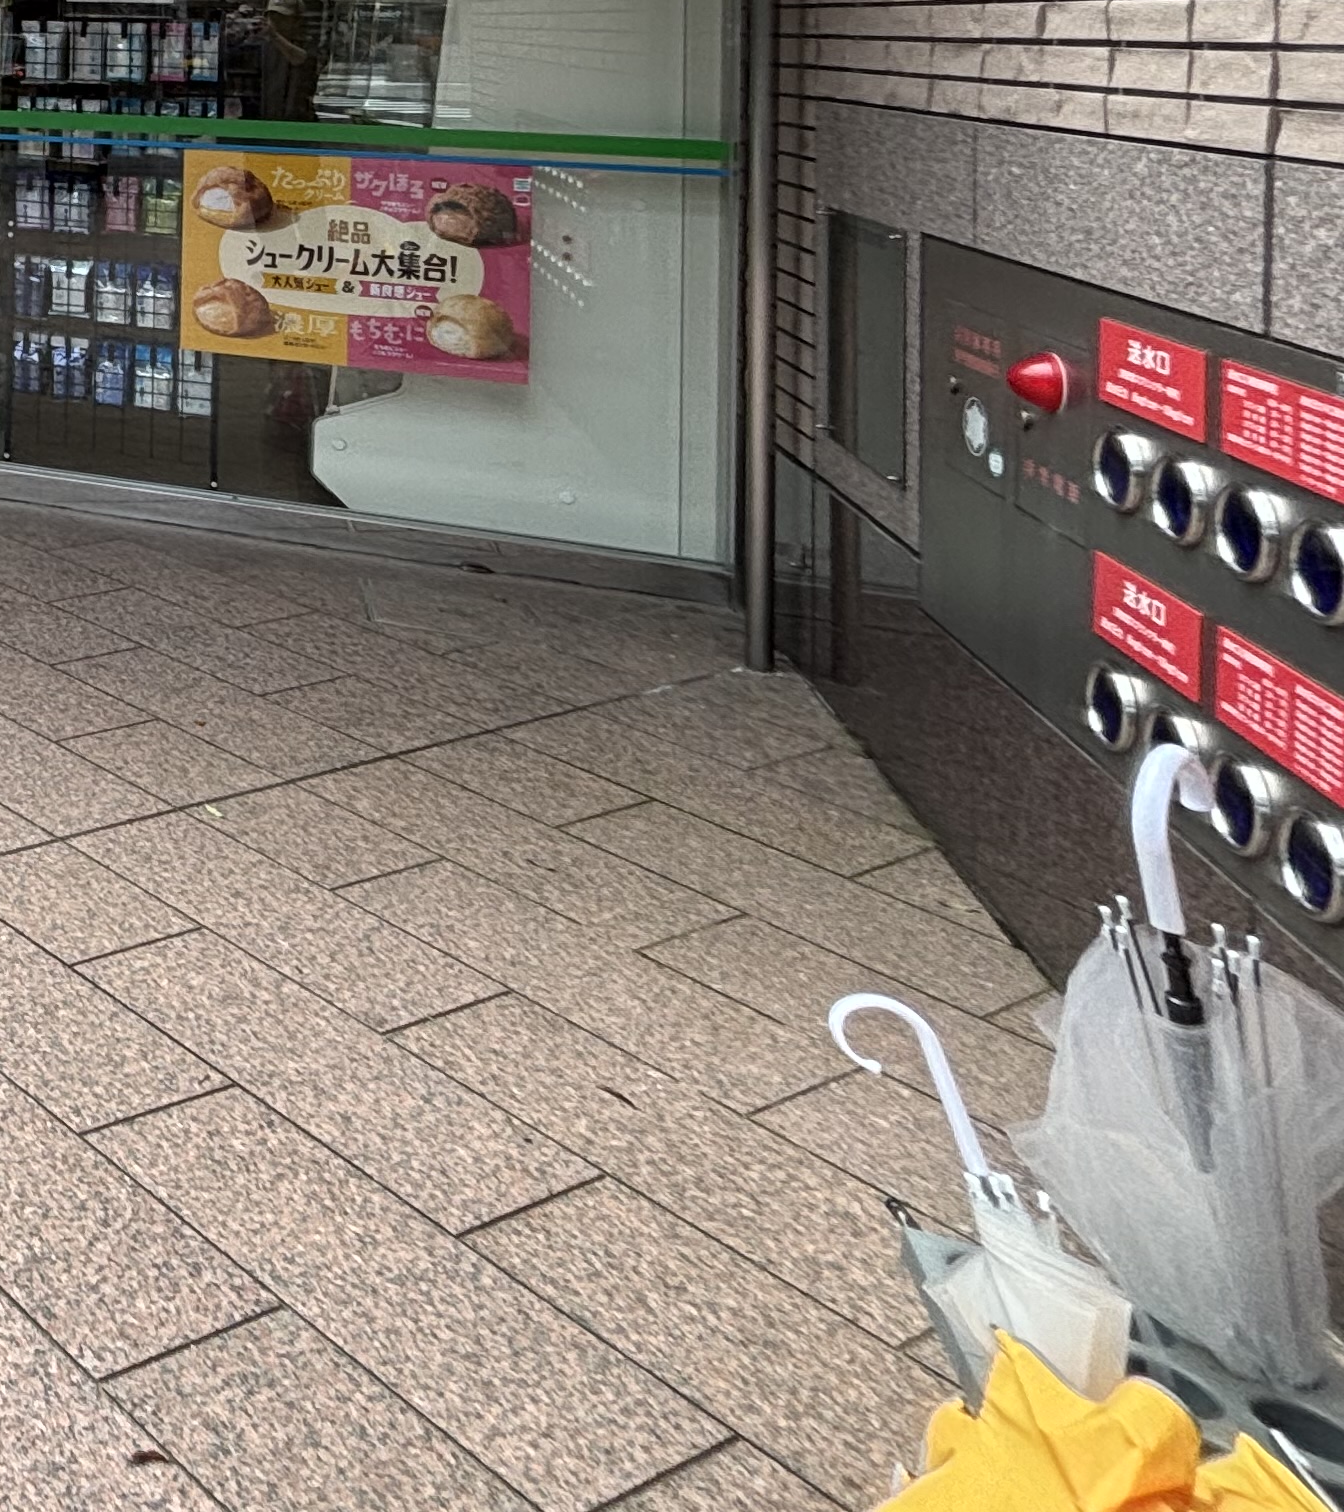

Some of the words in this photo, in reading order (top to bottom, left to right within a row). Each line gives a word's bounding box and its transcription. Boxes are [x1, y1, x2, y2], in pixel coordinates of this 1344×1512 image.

[271, 166, 347, 189] たっぷり
[354, 171, 425, 200] ザクほろ
[303, 188, 346, 201] クリーム
[327, 219, 371, 245] 絶品
[245, 239, 458, 284] シュークリーム大集合!
[271, 275, 331, 295] 大人気シュー
[341, 279, 356, 294] &
[272, 310, 339, 337] 濃厚
